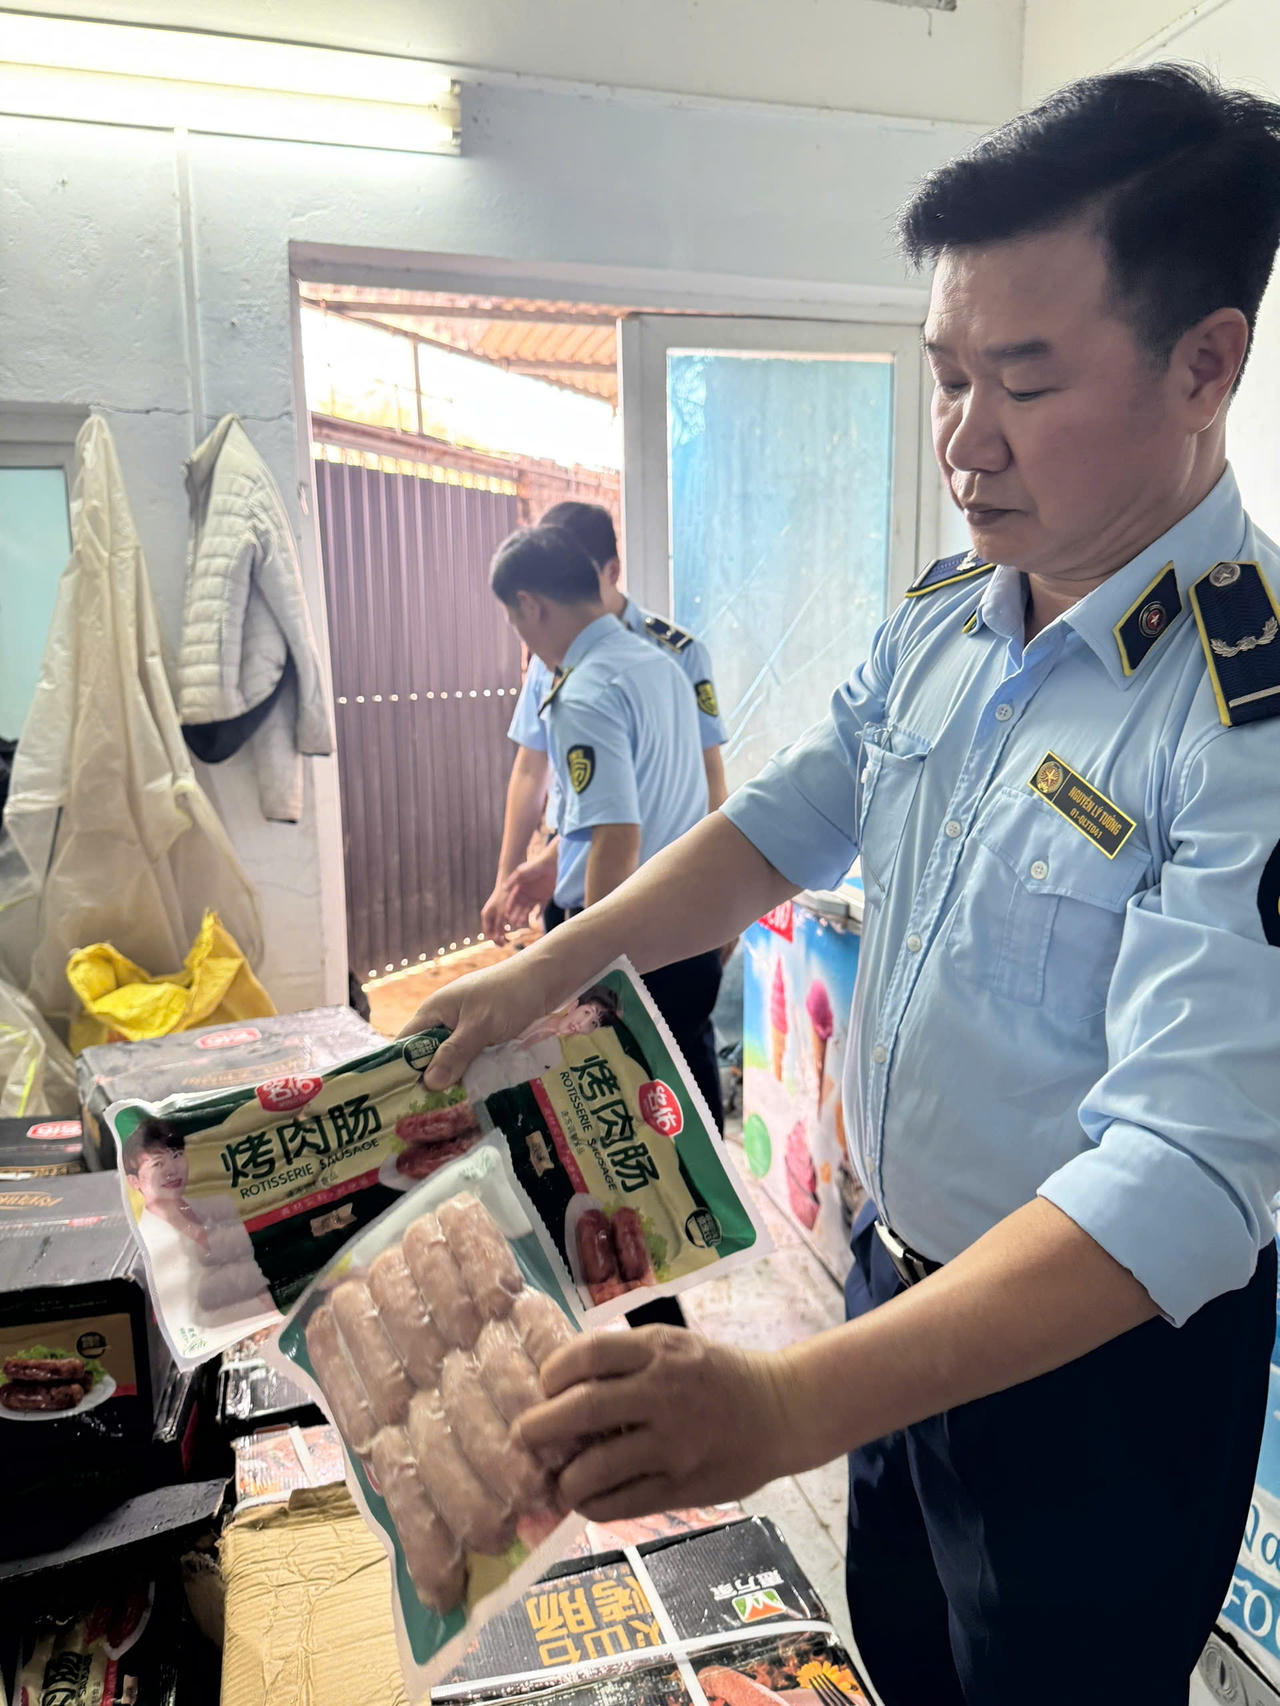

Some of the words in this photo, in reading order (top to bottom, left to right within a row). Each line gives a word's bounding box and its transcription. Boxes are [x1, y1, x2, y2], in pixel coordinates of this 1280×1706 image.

[220, 1093, 382, 1188] 烤肉肠
[560, 1071, 593, 1133] ROTISSERIE
[570, 1055, 660, 1193] 烤肉肠
[240, 1163, 314, 1199] ROTISSERIE
[320, 1138, 380, 1170] SAUSAGE
